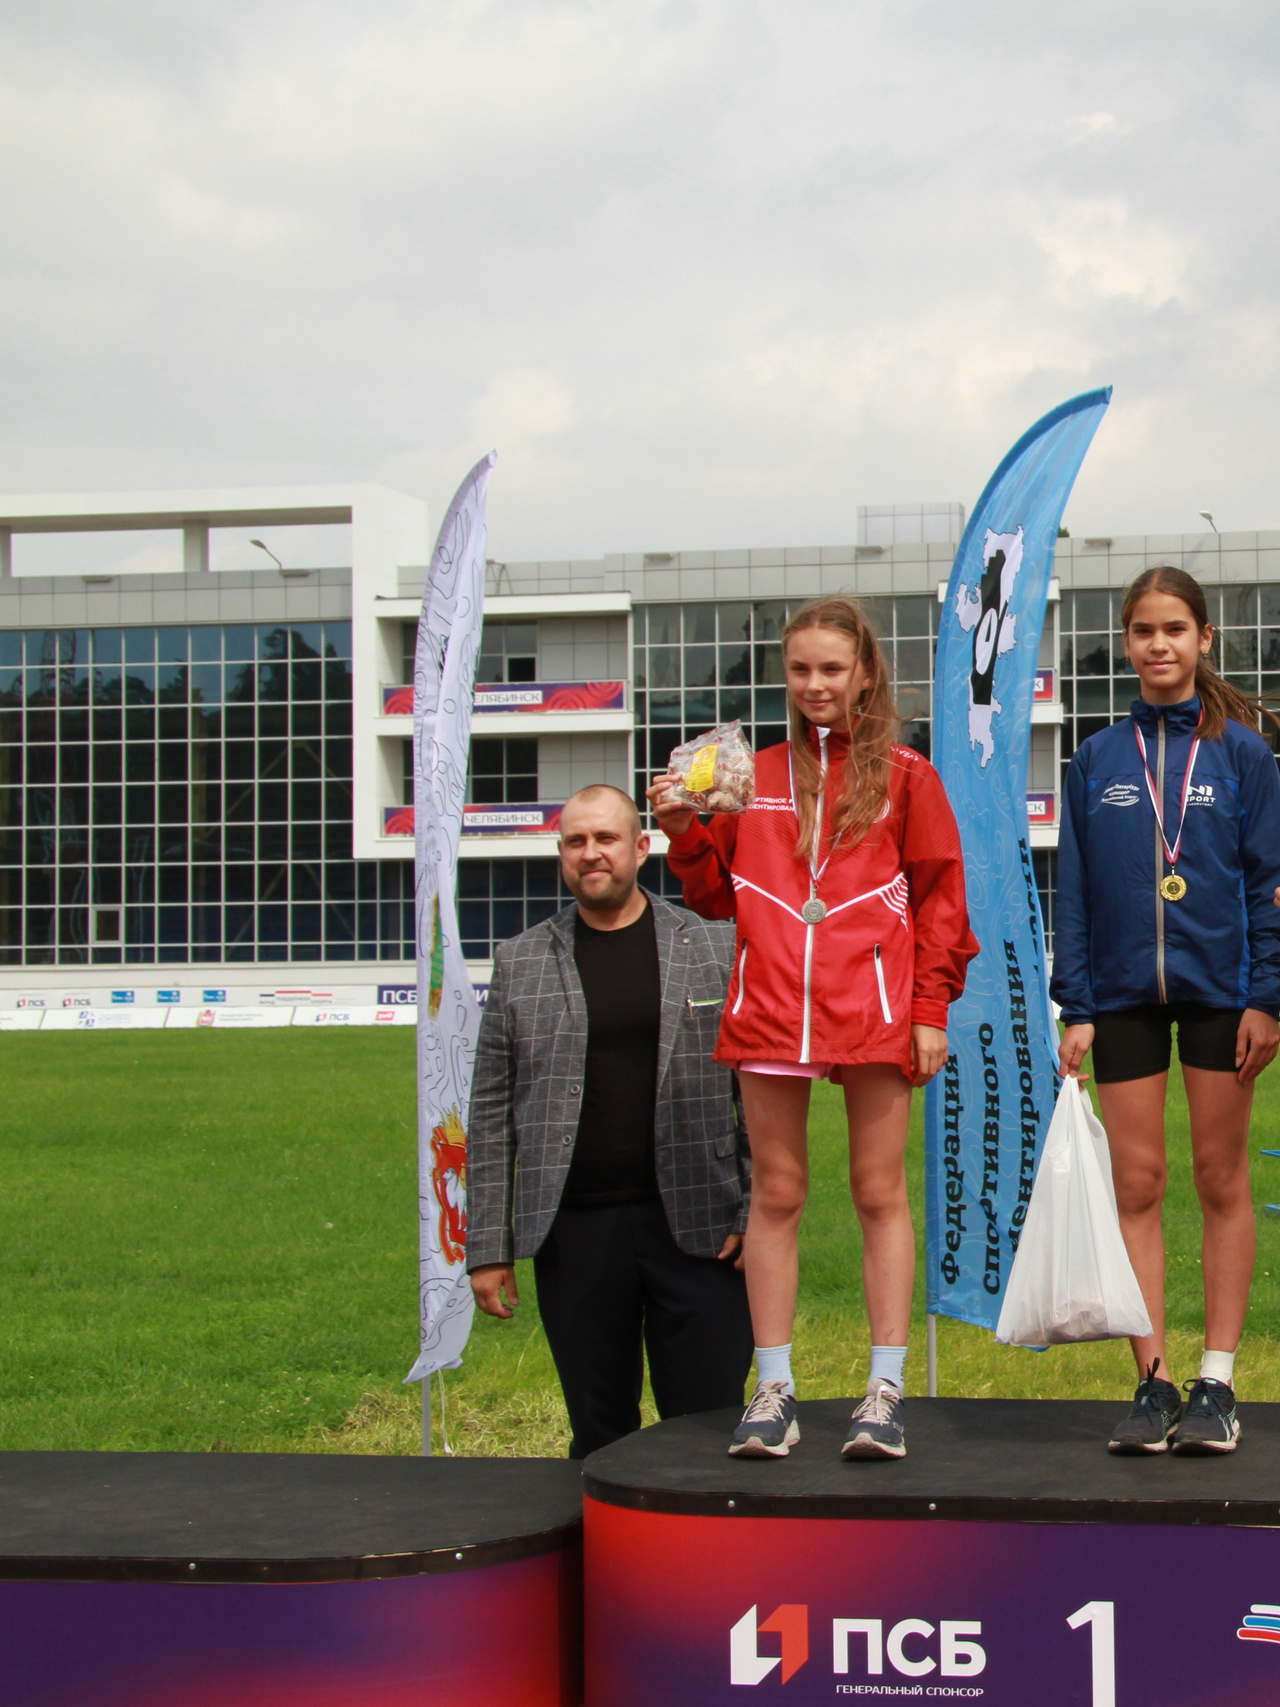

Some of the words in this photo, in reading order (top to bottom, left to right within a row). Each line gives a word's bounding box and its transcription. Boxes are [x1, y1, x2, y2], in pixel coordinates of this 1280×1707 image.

[473, 691, 540, 704] ЕЛЯБИНСК
[465, 813, 541, 825] ЧЕЛЯБИНСК
[382, 990, 417, 1004] ПСБ
[1003, 938, 1040, 1256] иентирования
[940, 1054, 966, 1285] Федерация
[980, 1022, 1002, 1296] спортивного
[832, 1617, 987, 1677] ПСБ
[1066, 1600, 1116, 1707] 1
[836, 1684, 923, 1696] ГЕНЕРАЛЬНЫЙ
[926, 1686, 984, 1698] СПОНСОР
